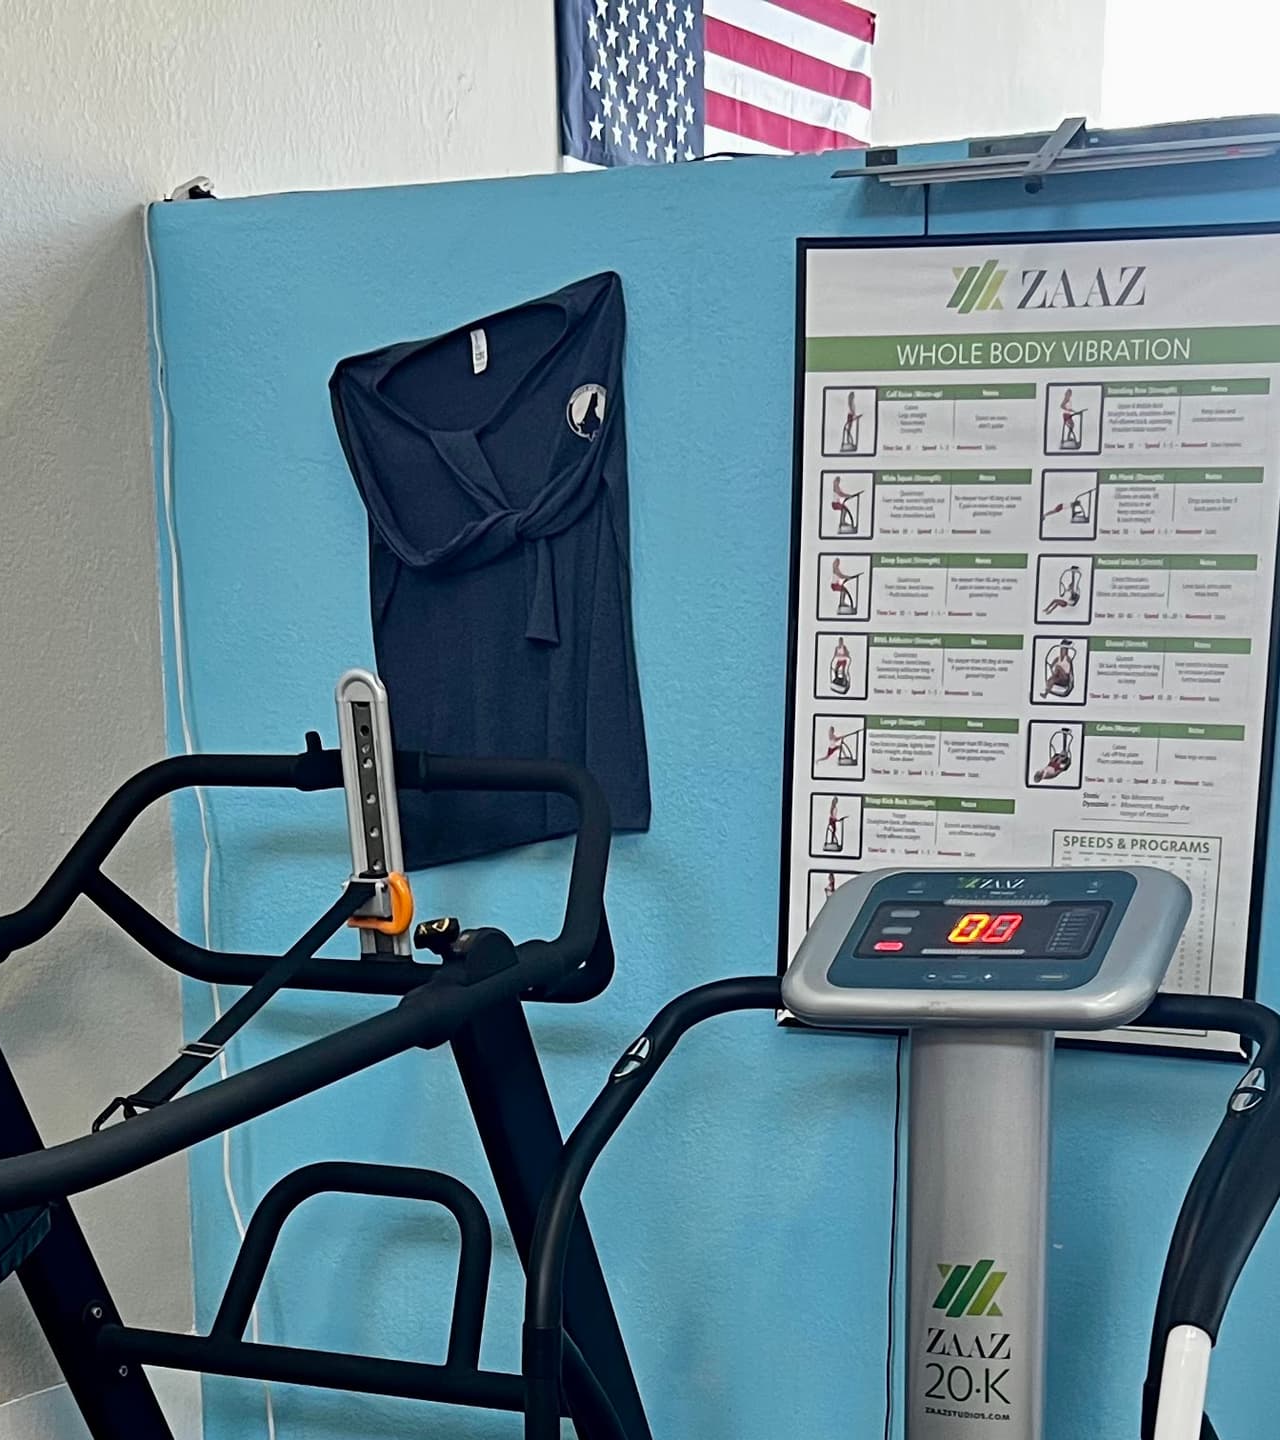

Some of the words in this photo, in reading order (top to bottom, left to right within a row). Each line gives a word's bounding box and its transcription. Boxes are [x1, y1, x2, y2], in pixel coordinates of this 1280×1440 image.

[1017, 266, 1147, 310] ZAAZ
[896, 343, 983, 366] WHOLE
[989, 341, 1056, 365] BODY
[1061, 338, 1191, 363] VIBRATION
[1063, 835, 1114, 850] SPEEDS
[1116, 837, 1127, 850] &
[1130, 838, 1211, 854] PROGRAMS
[947, 912, 1023, 944] 00
[926, 1327, 1011, 1360] ZAAZ
